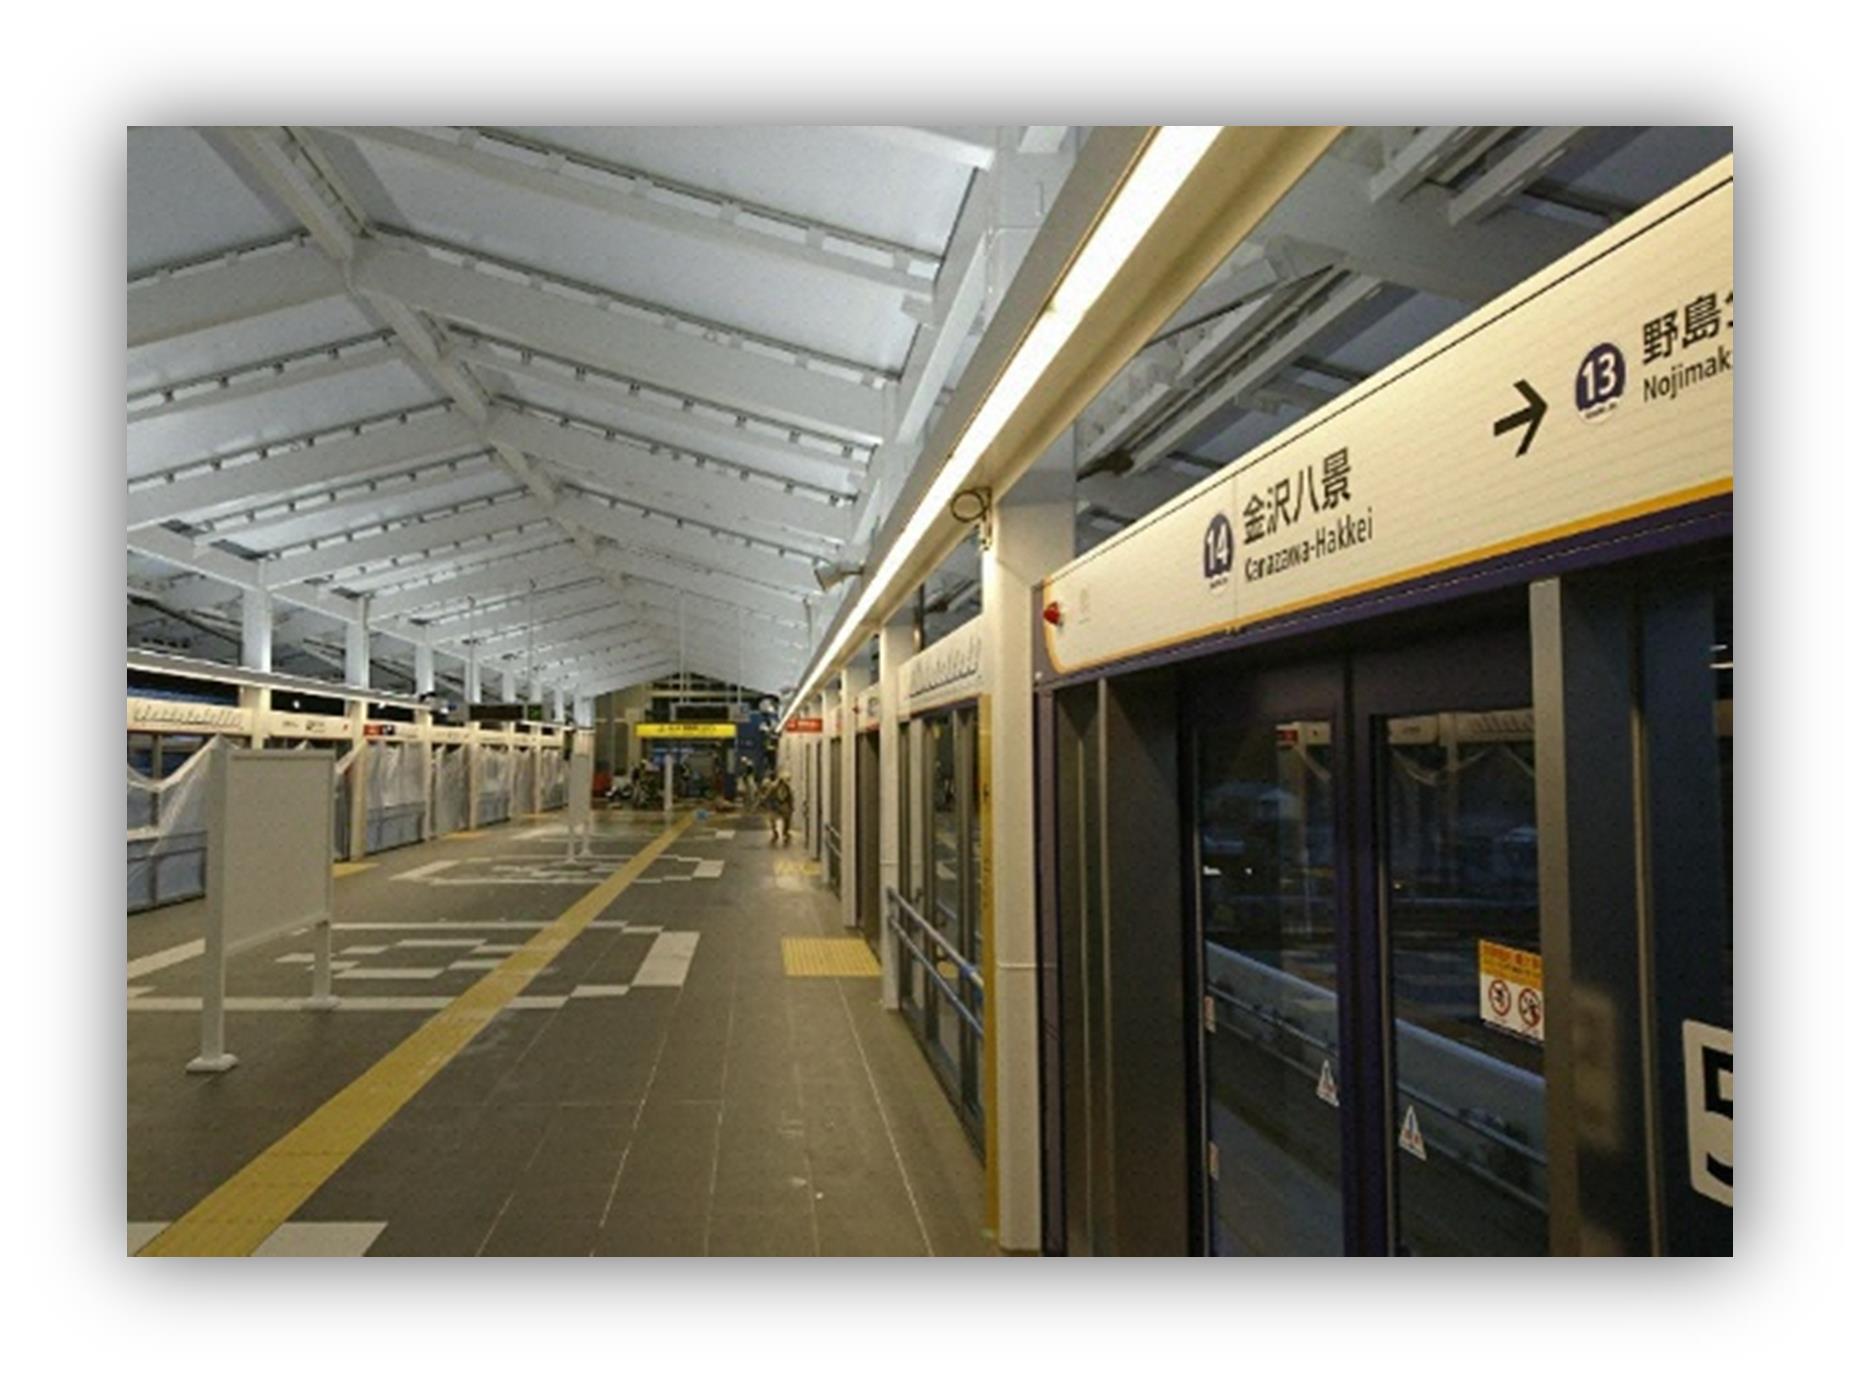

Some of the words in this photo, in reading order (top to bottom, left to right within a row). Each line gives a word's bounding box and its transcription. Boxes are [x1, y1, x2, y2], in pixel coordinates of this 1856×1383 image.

[1582, 351, 1617, 401] 13
[1242, 446, 1352, 545] 金沢八景
[1206, 522, 1229, 571] 14
[1244, 506, 1373, 582] Kanazawa-Hakkei
